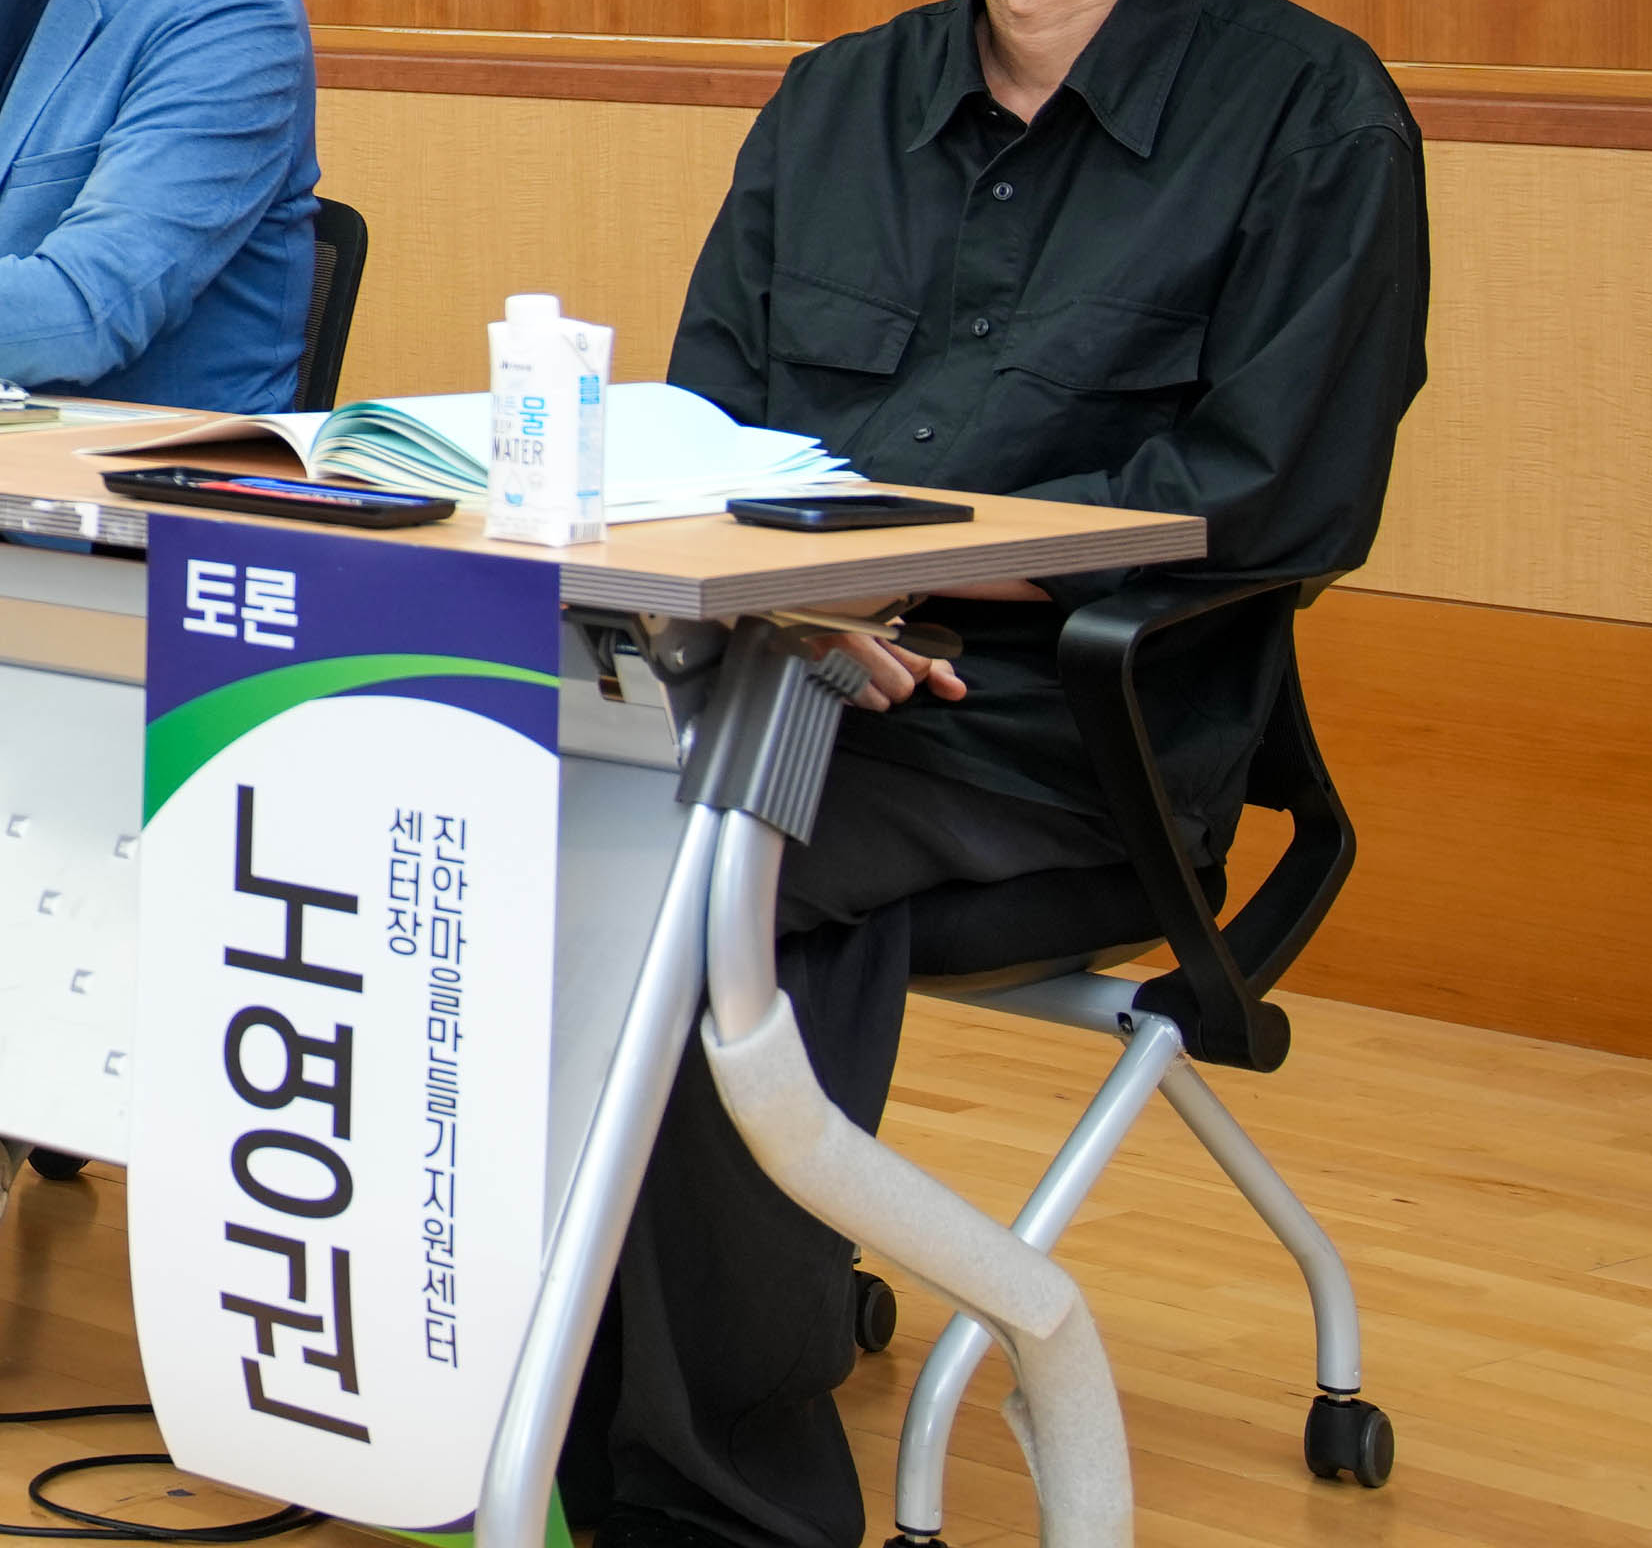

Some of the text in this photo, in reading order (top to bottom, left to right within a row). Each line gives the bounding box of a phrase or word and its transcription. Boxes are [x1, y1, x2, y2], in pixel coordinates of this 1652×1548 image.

[492, 436, 545, 466] WATER
[183, 557, 299, 650] 토론
[386, 806, 424, 957] 센터장
[220, 783, 372, 1444] 노영권
[421, 814, 470, 1370] 진안마을만들기지원센터
